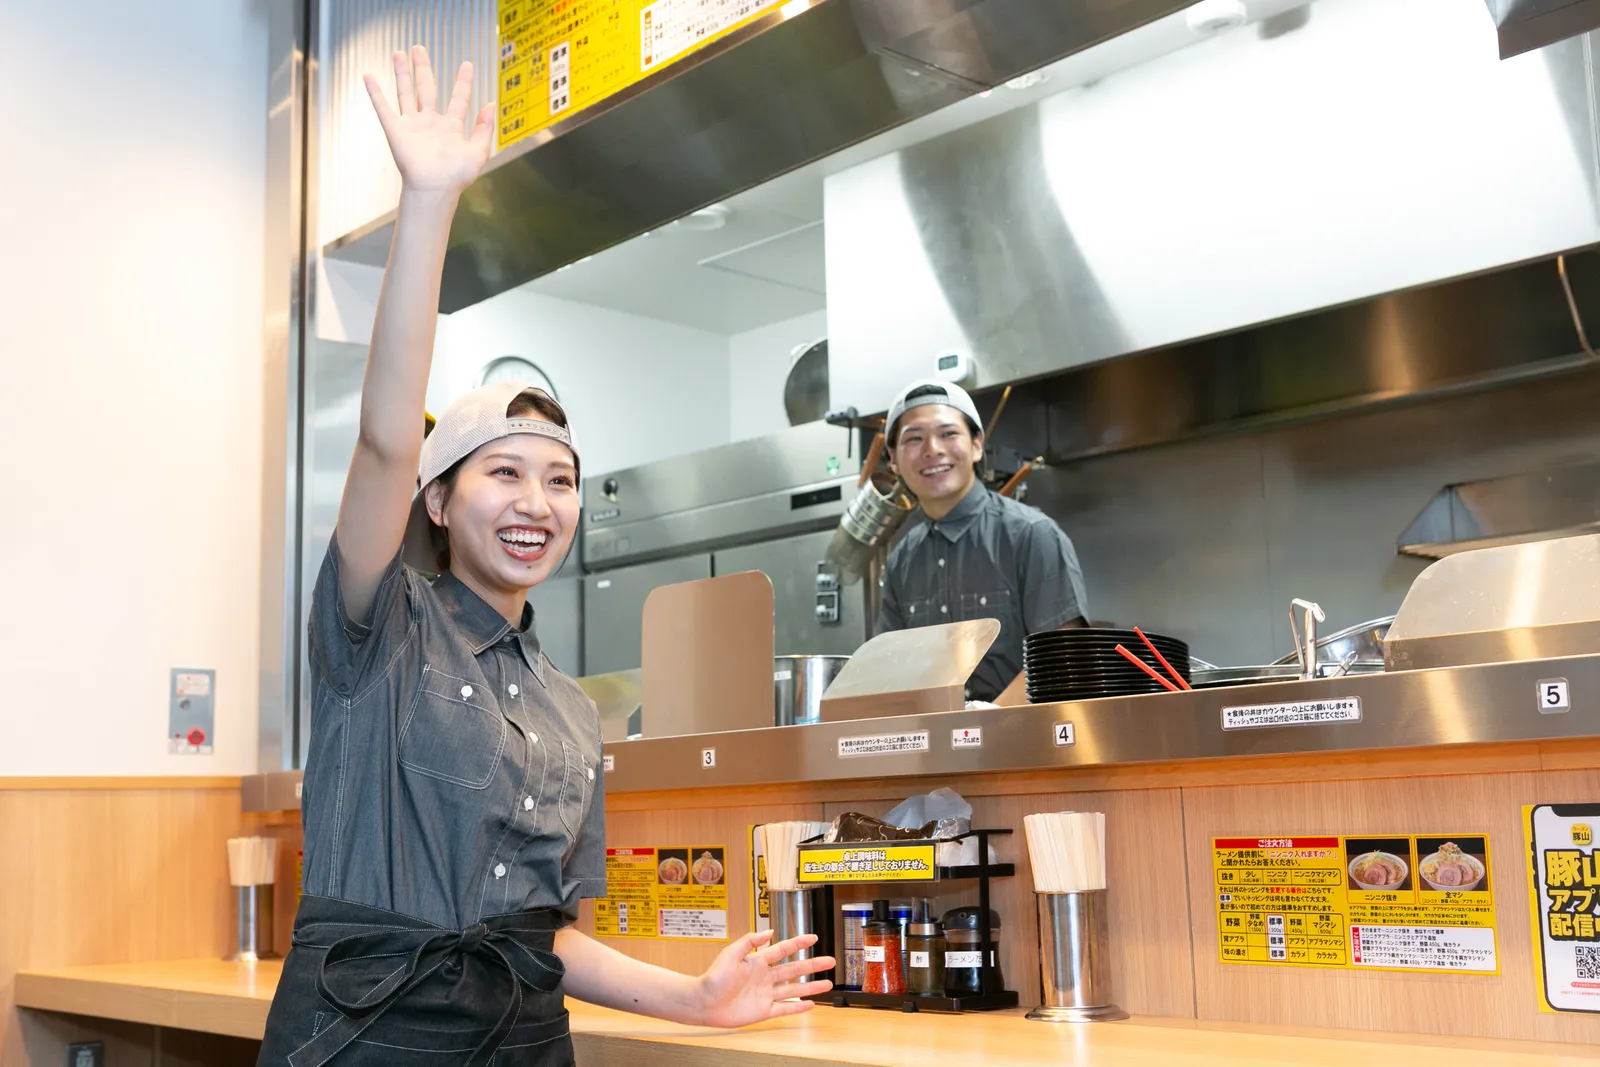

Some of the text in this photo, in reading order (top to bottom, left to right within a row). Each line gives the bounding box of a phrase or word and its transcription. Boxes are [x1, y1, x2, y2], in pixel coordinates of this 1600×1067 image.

[1547, 685, 1560, 704] 5
[1059, 726, 1068, 742] 4
[706, 752, 712, 764] 3
[1572, 832, 1590, 841] 豚山
[1258, 839, 1292, 848] ご注文方法
[844, 850, 886, 862] 卓上調味料は
[1549, 888, 1600, 912] アプ
[1226, 918, 1240, 927] 野菜
[1550, 913, 1600, 936] 配信
